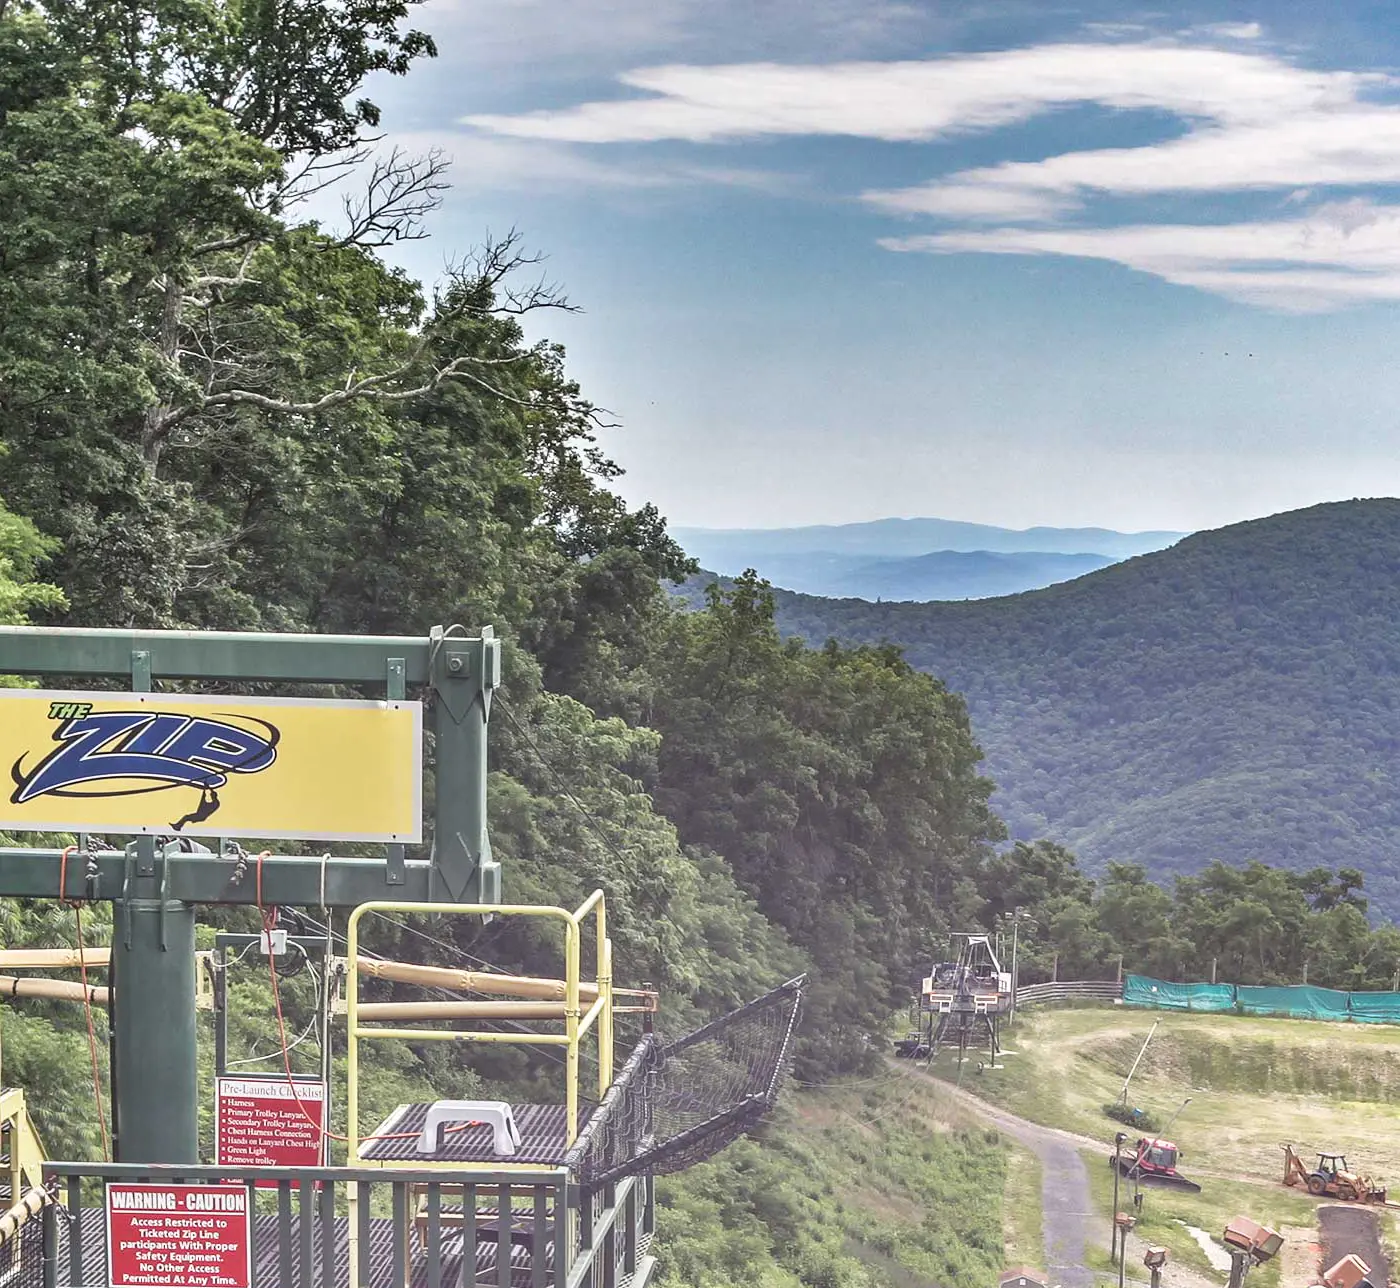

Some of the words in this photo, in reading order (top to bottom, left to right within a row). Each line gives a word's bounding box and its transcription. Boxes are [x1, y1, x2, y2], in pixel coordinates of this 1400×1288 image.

[48, 702, 92, 720] THE
[12, 711, 277, 803] ZIP
[224, 1083, 277, 1096] Pre-Launch
[279, 1085, 322, 1097] Chcklist
[227, 1099, 254, 1107] Harness
[227, 1108, 253, 1117] Primary
[255, 1110, 278, 1119] Trolley
[279, 1111, 306, 1120] Lanyar
[227, 1118, 260, 1127] Secondary
[263, 1119, 286, 1129] Trolley
[287, 1120, 314, 1129] Lanyar
[274, 1129, 312, 1138] Connection
[227, 1137, 248, 1145] Hands
[258, 1138, 285, 1148] Lanyard
[286, 1139, 305, 1147] Chest
[227, 1146, 247, 1154] Green
[248, 1147, 266, 1156] Light
[227, 1156, 254, 1164] Remove
[111, 1191, 176, 1210] WARNING
[186, 1193, 245, 1211] CAUTION
[130, 1217, 163, 1227] Access
[165, 1217, 214, 1228] Restricted
[216, 1219, 227, 1228] to
[139, 1228, 180, 1239] Ticketed
[182, 1229, 196, 1240] Zip
[199, 1230, 220, 1239] Line
[120, 1240, 176, 1251] participants
[179, 1240, 203, 1250] With
[205, 1241, 238, 1252] Proper
[135, 1251, 168, 1263] Safety
[170, 1252, 224, 1263] Equipment.
[140, 1263, 153, 1272] No
[156, 1263, 184, 1273] Other
[187, 1264, 219, 1273] Access
[122, 1274, 171, 1284] Permitted
[173, 1274, 186, 1284] At
[187, 1275, 208, 1286] Any
[210, 1275, 237, 1285] Time.
